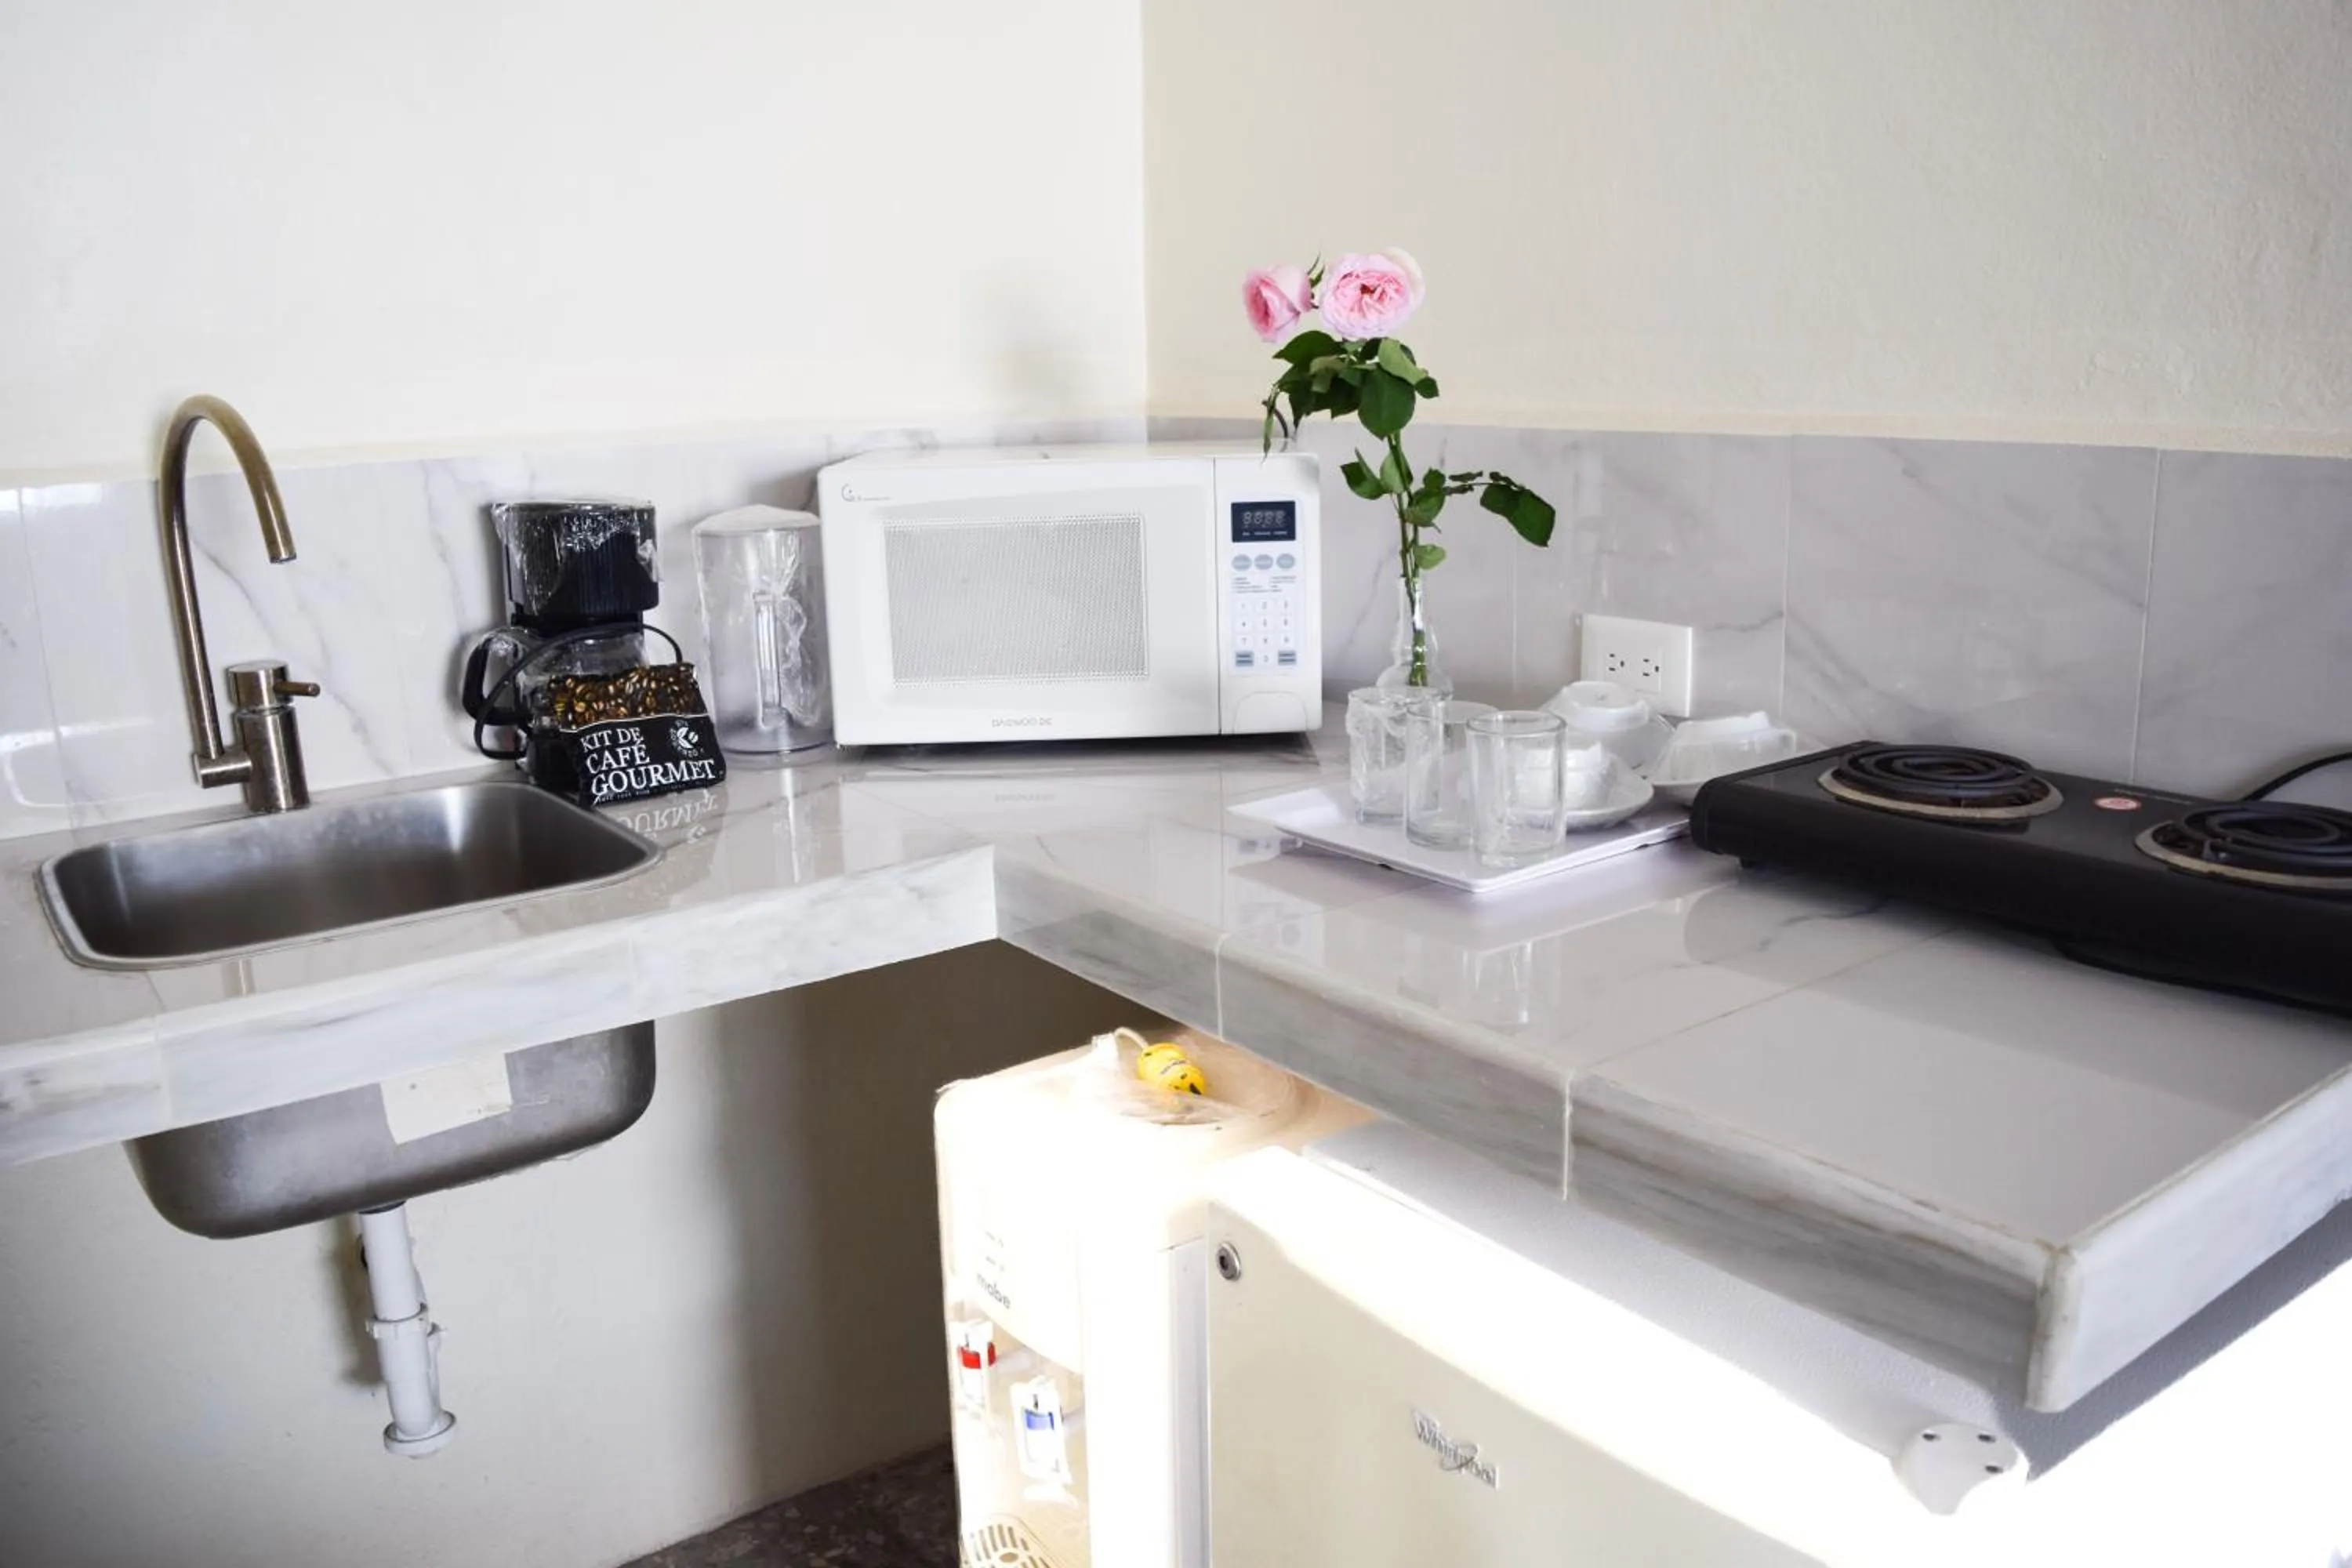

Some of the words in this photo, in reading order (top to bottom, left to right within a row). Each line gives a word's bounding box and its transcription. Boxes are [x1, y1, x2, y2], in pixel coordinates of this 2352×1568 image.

[580, 730, 614, 753] KIT
[615, 727, 644, 745] DE
[586, 742, 650, 775] CAFÉ
[591, 759, 717, 797] GOURMET
[976, 1272, 1011, 1309] mabe
[1410, 1409, 1499, 1491] Whirlpool
